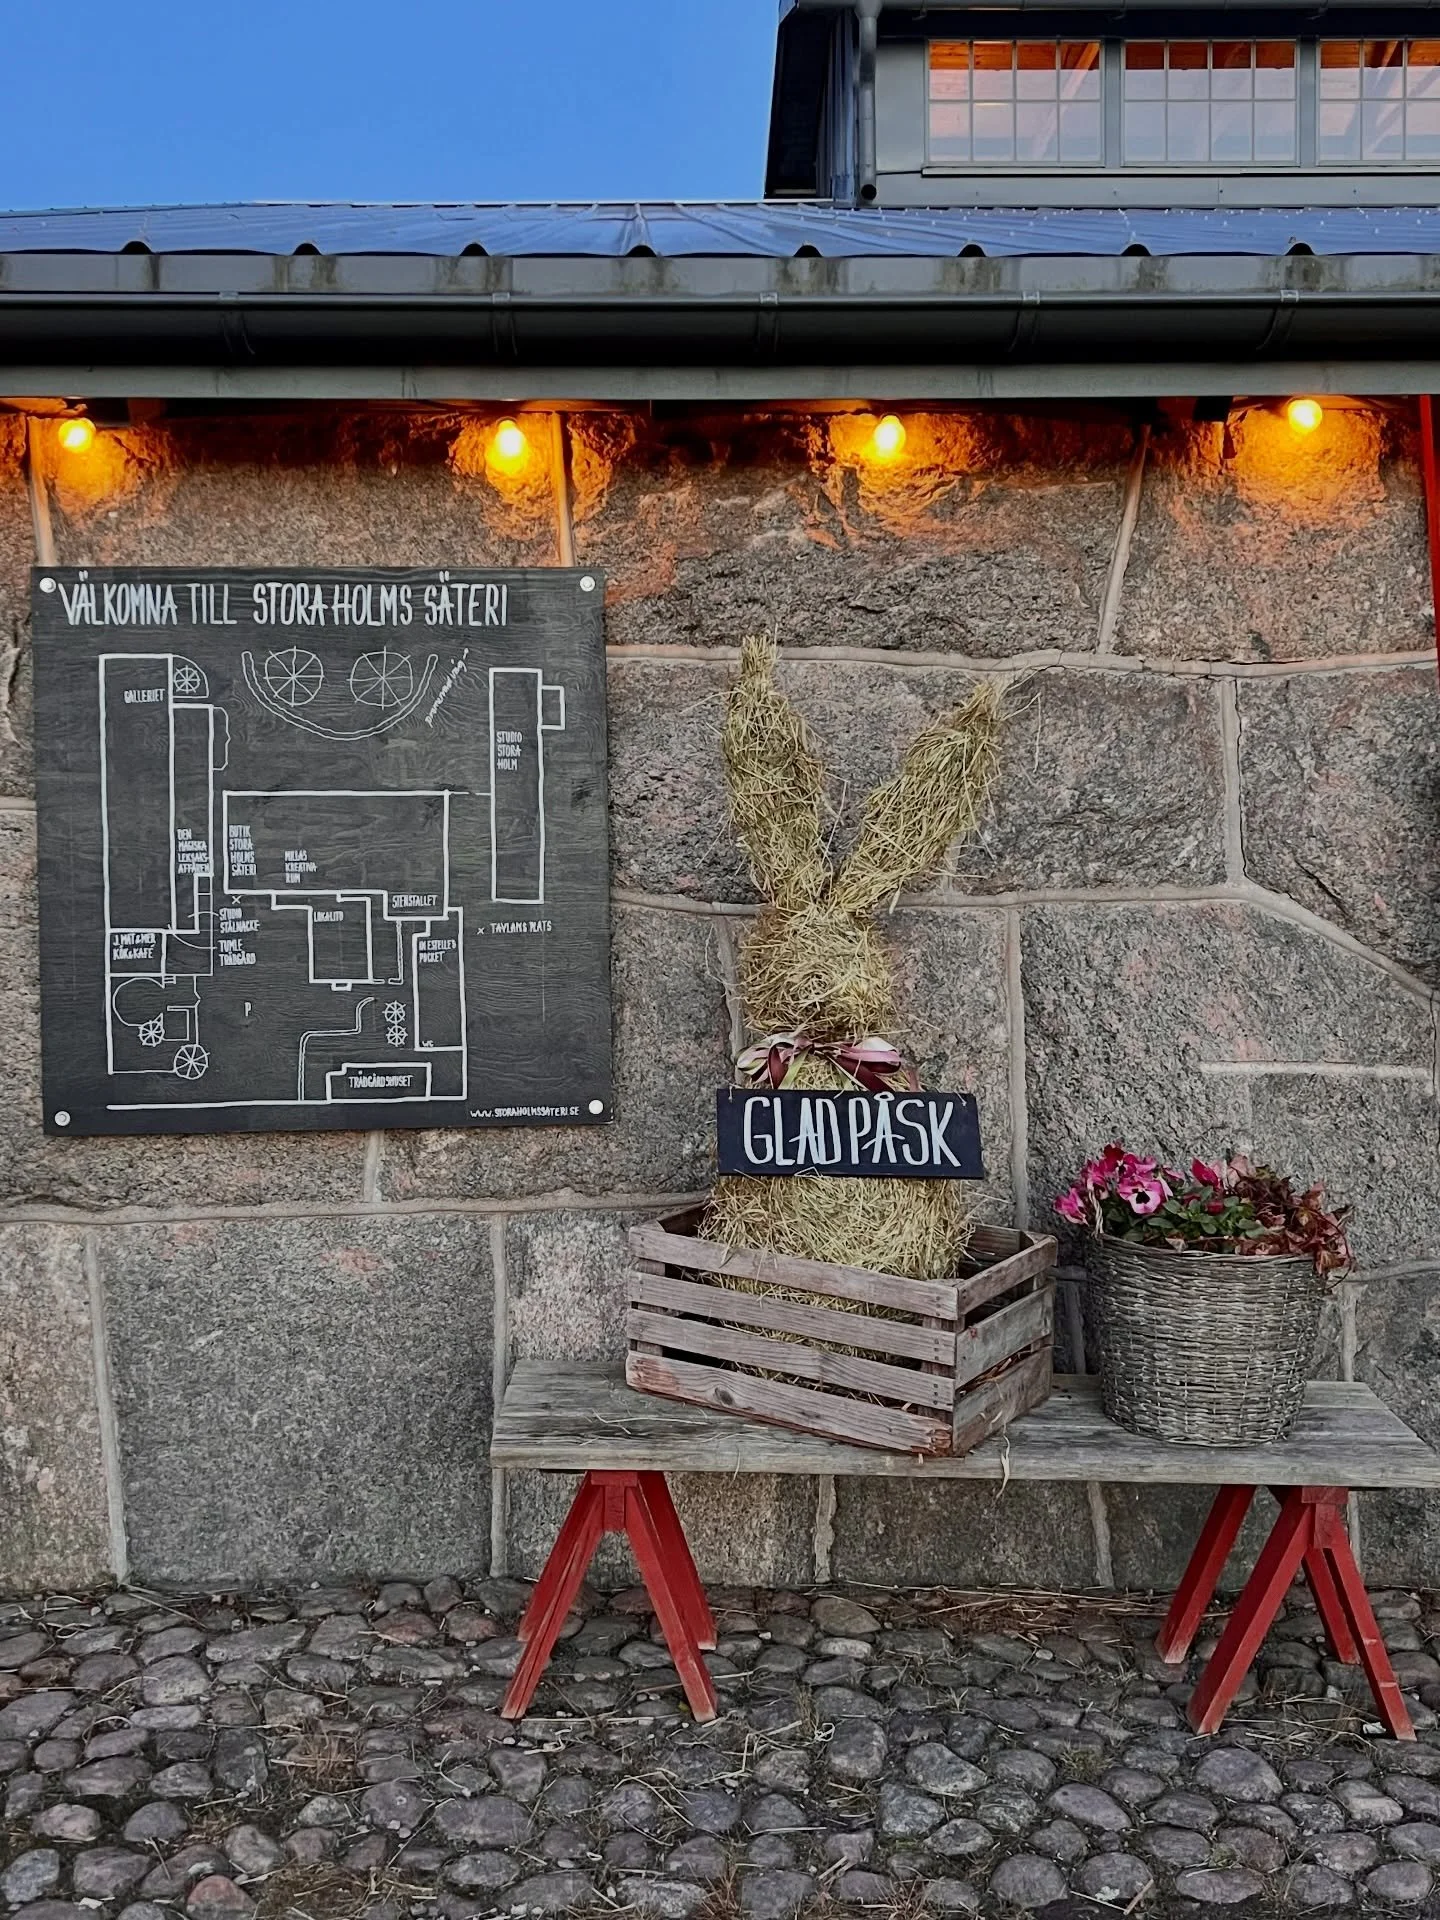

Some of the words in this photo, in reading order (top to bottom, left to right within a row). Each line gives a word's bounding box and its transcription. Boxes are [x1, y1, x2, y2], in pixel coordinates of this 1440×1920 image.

[58, 570, 178, 626] VÄLKOMNA
[186, 582, 238, 625] TILL
[253, 582, 329, 626] STORA
[331, 584, 413, 627] HOLMS
[424, 570, 508, 627] SÄTERI
[124, 688, 166, 704] GALLERIET
[496, 731, 523, 744] STUDIO
[497, 744, 522, 757] STORA
[497, 758, 518, 771] HOLM
[177, 828, 192, 840] DEN
[229, 825, 251, 838] BUTIK
[178, 840, 208, 852] MAGISKA
[230, 838, 253, 850] STORA
[231, 851, 255, 863] HOLMS
[285, 850, 307, 861] MILLAS
[231, 863, 257, 877] SÄTERI
[285, 862, 317, 873] KREATIVA
[285, 872, 301, 884] RUM
[219, 907, 242, 921] STUDIO
[218, 938, 243, 952] TUMLE
[218, 951, 257, 967] TRÄDGÅRD
[419, 950, 446, 964] POCKET
[244, 1001, 252, 1017] P
[743, 1096, 842, 1165] GLAD
[849, 1090, 962, 1167] PÅSK
